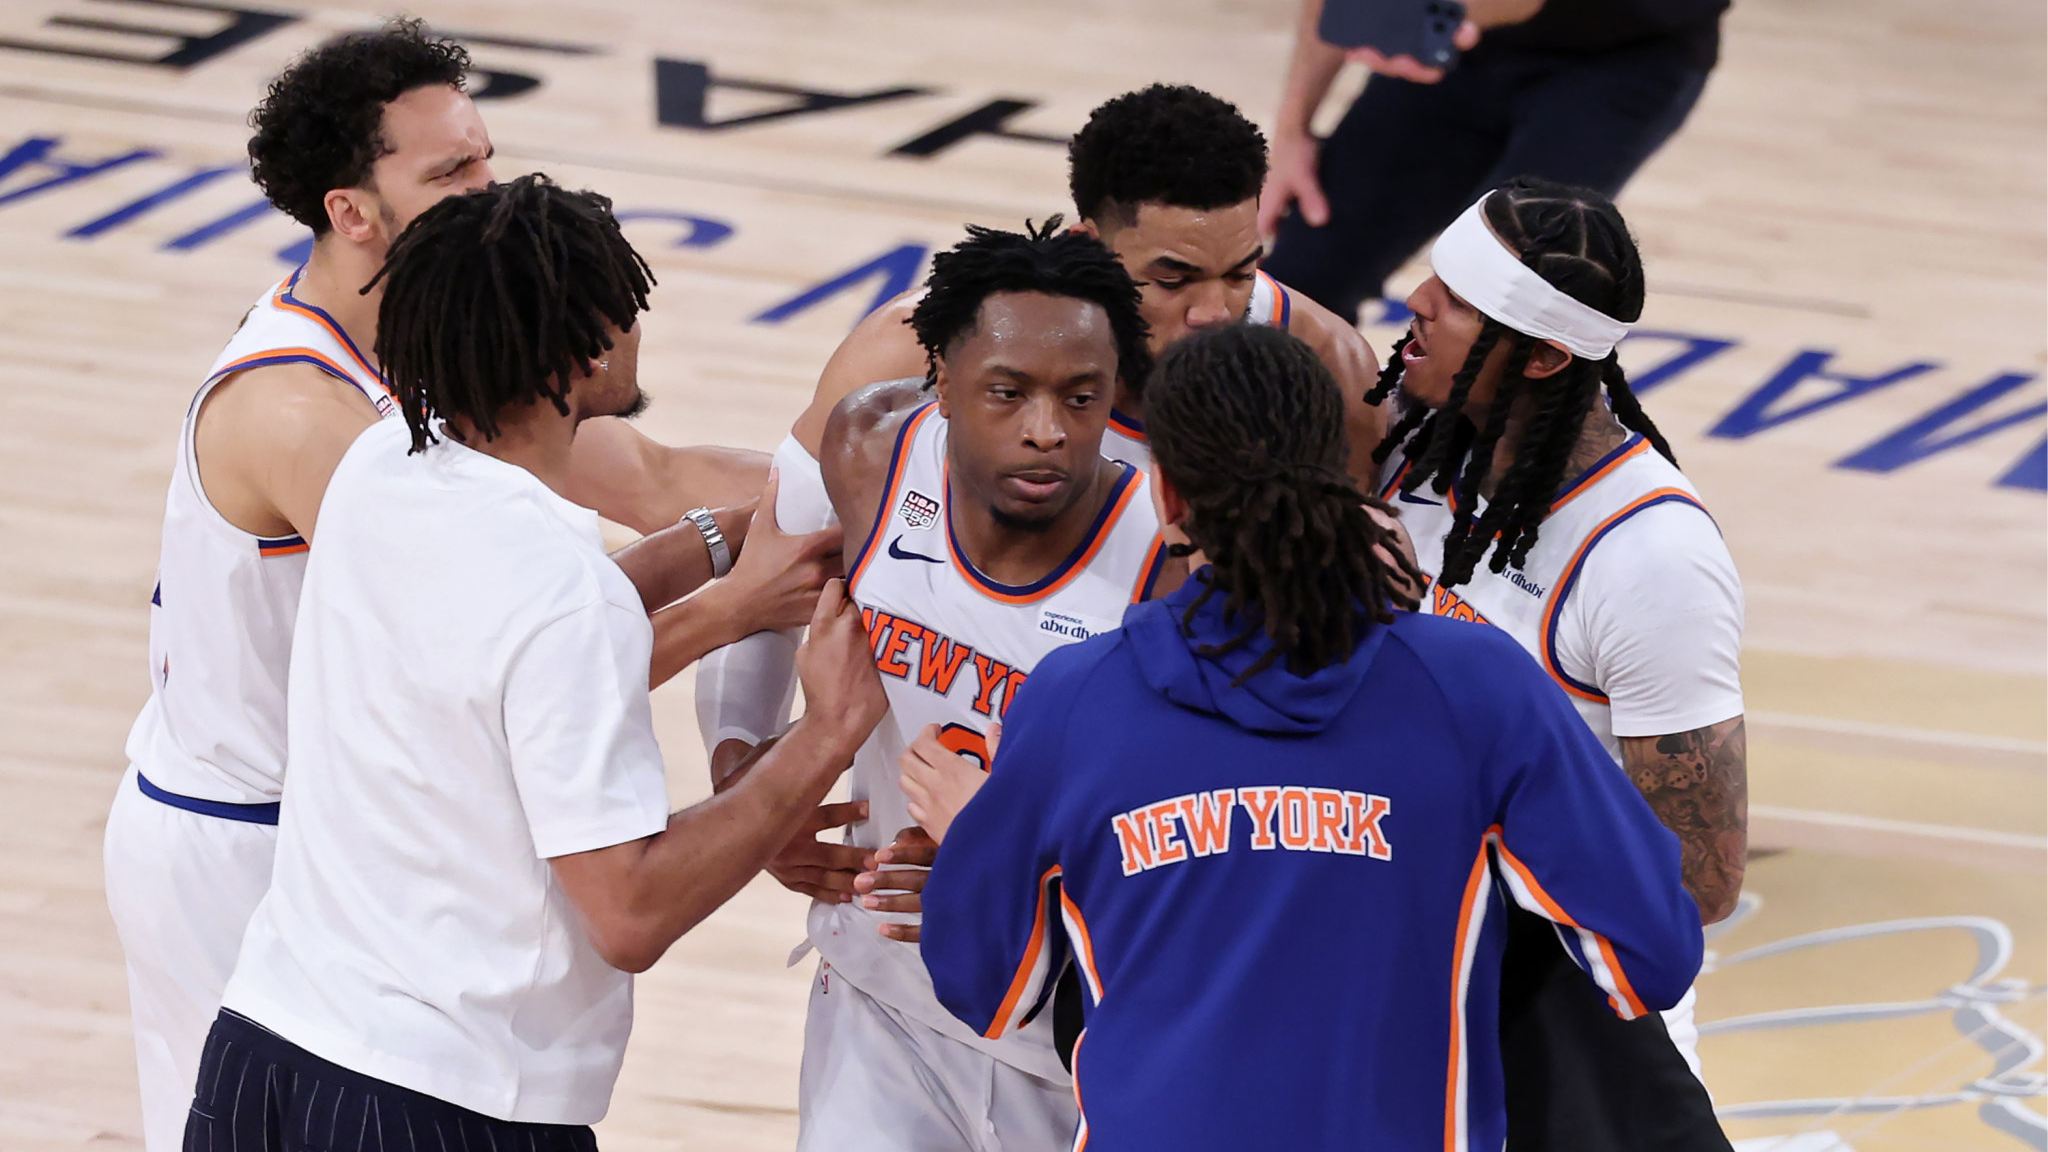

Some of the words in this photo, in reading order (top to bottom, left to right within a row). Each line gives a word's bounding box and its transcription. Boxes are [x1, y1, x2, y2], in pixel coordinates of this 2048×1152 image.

[907, 492, 936, 513] USA
[899, 506, 933, 527] 250
[1040, 619, 1069, 635] abu
[1112, 788, 1236, 876] NEW
[1238, 786, 1392, 861] YORK
